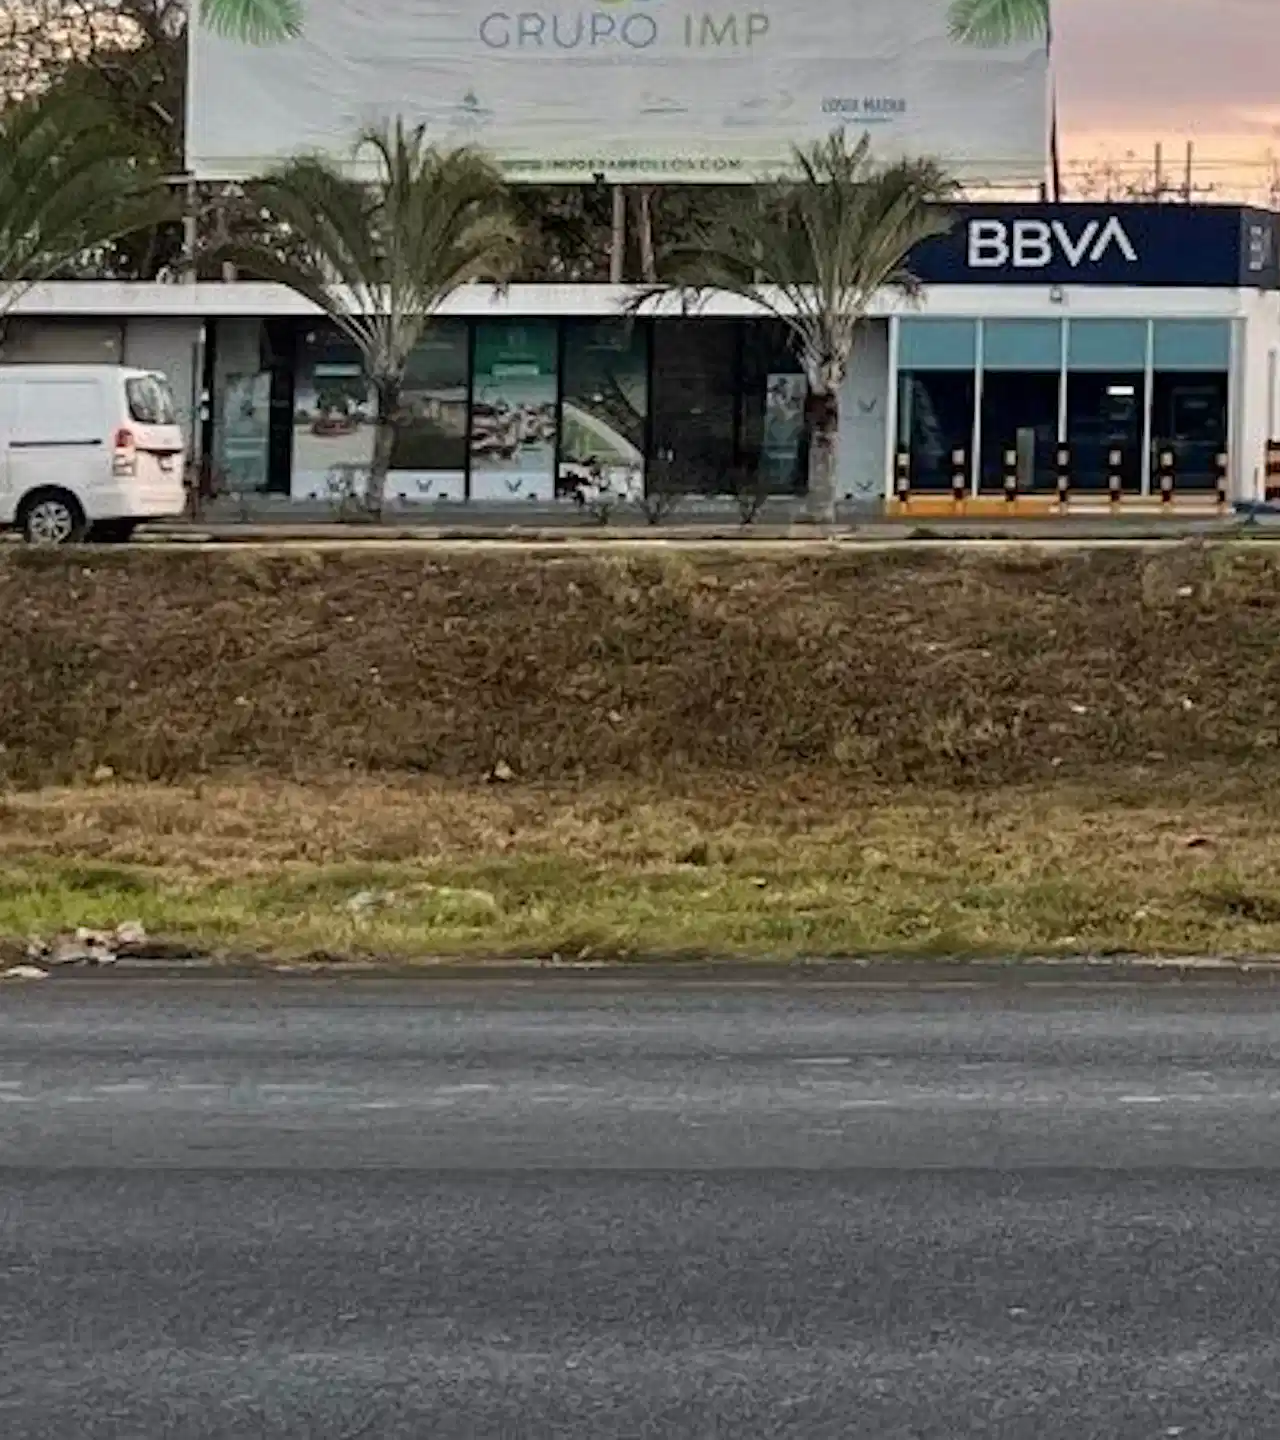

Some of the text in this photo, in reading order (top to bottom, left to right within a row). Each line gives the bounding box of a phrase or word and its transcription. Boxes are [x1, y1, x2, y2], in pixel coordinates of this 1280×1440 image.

[479, 12, 770, 48] GRUPO IMP
[967, 216, 1138, 268] BBVA
